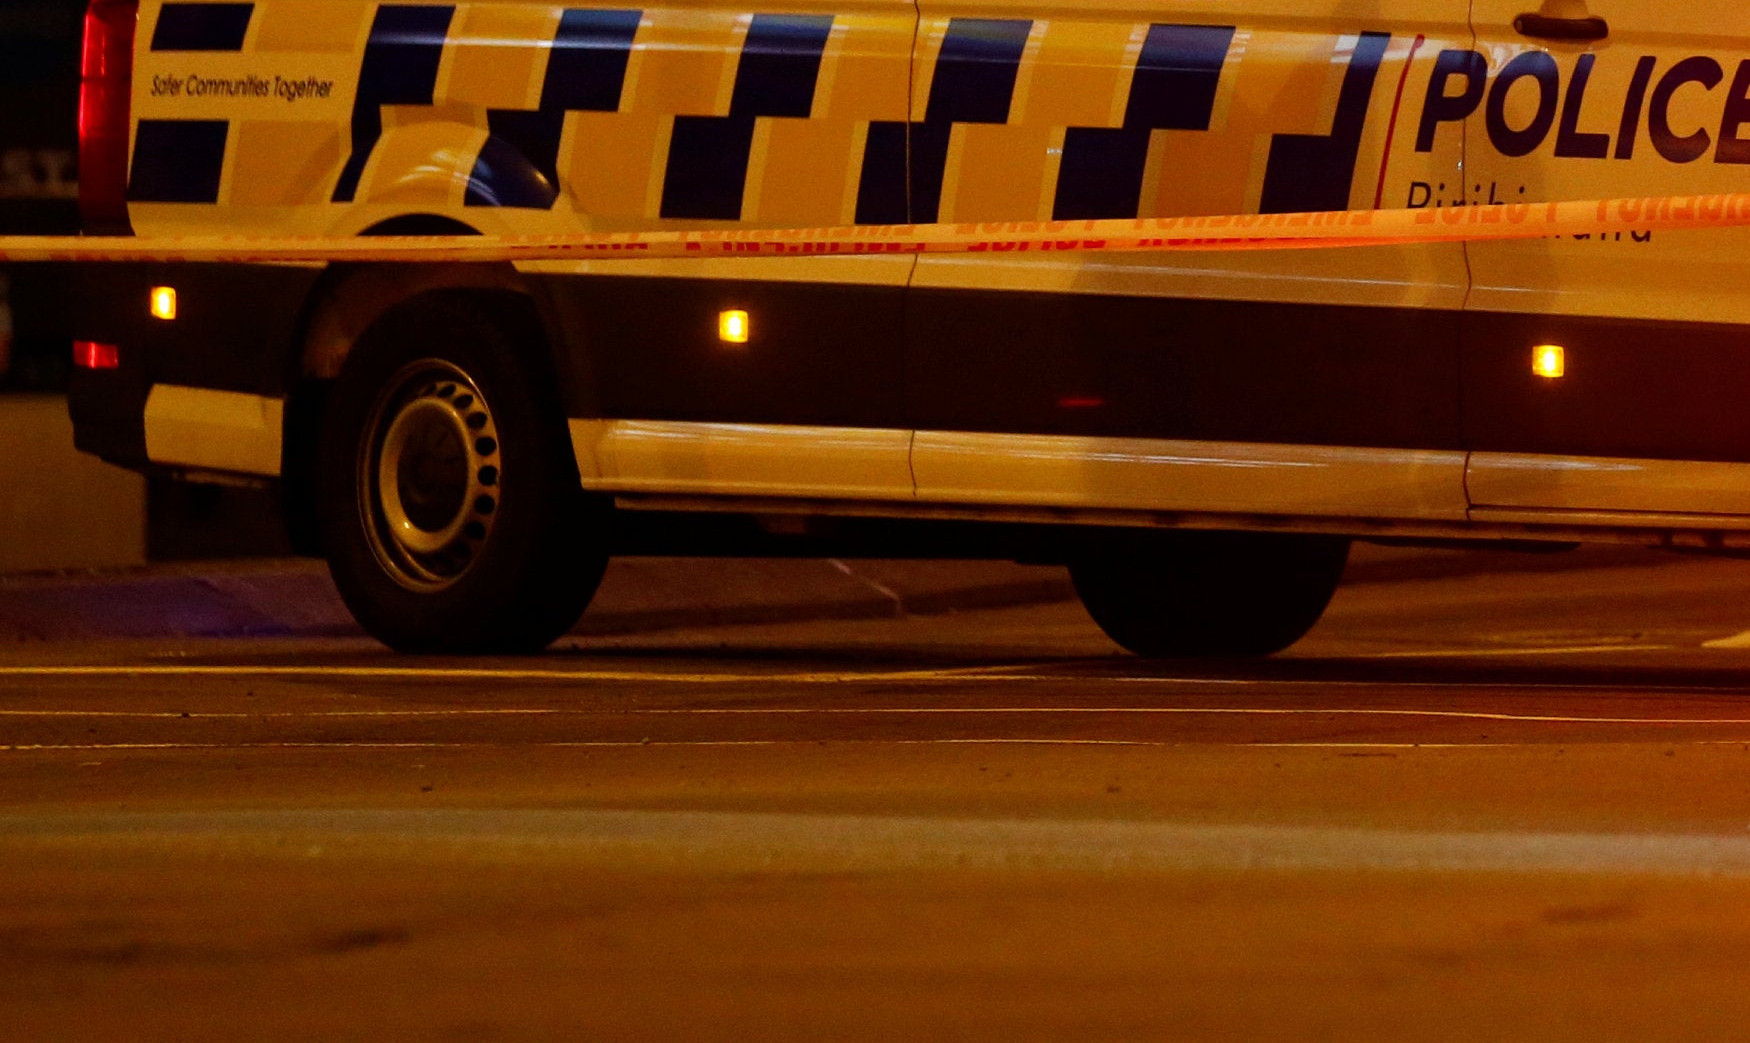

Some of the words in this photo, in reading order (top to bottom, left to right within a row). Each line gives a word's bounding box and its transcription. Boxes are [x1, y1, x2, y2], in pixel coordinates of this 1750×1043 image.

[151, 74, 183, 97] Safer
[186, 73, 270, 97] Communities
[274, 75, 334, 103] Together
